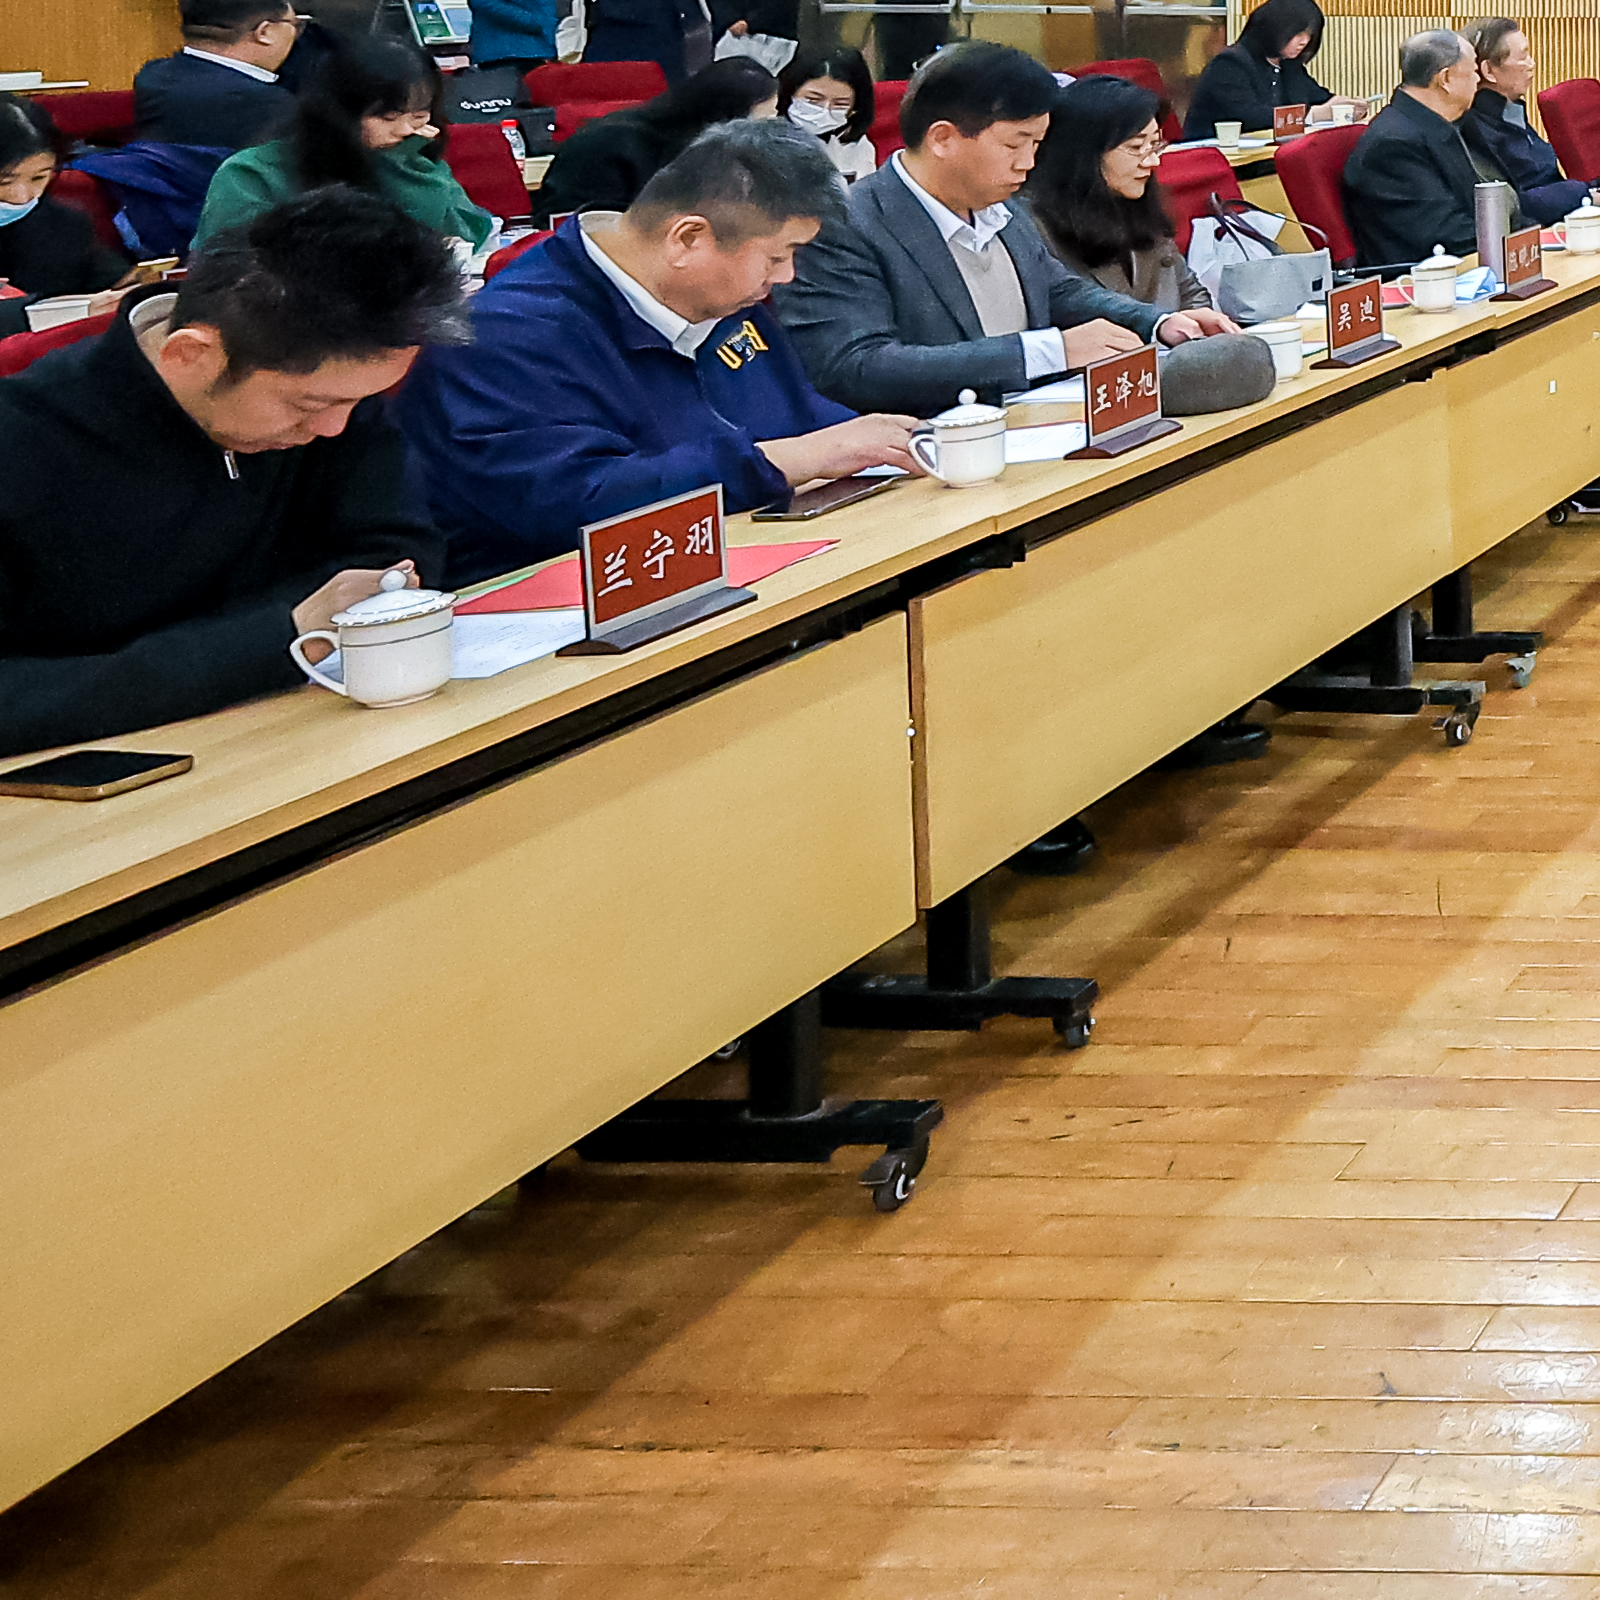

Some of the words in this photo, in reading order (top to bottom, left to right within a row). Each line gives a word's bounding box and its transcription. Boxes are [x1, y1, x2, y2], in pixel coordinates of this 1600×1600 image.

[1337, 294, 1377, 332] 吴迪
[597, 515, 714, 597] 兰宁羽
